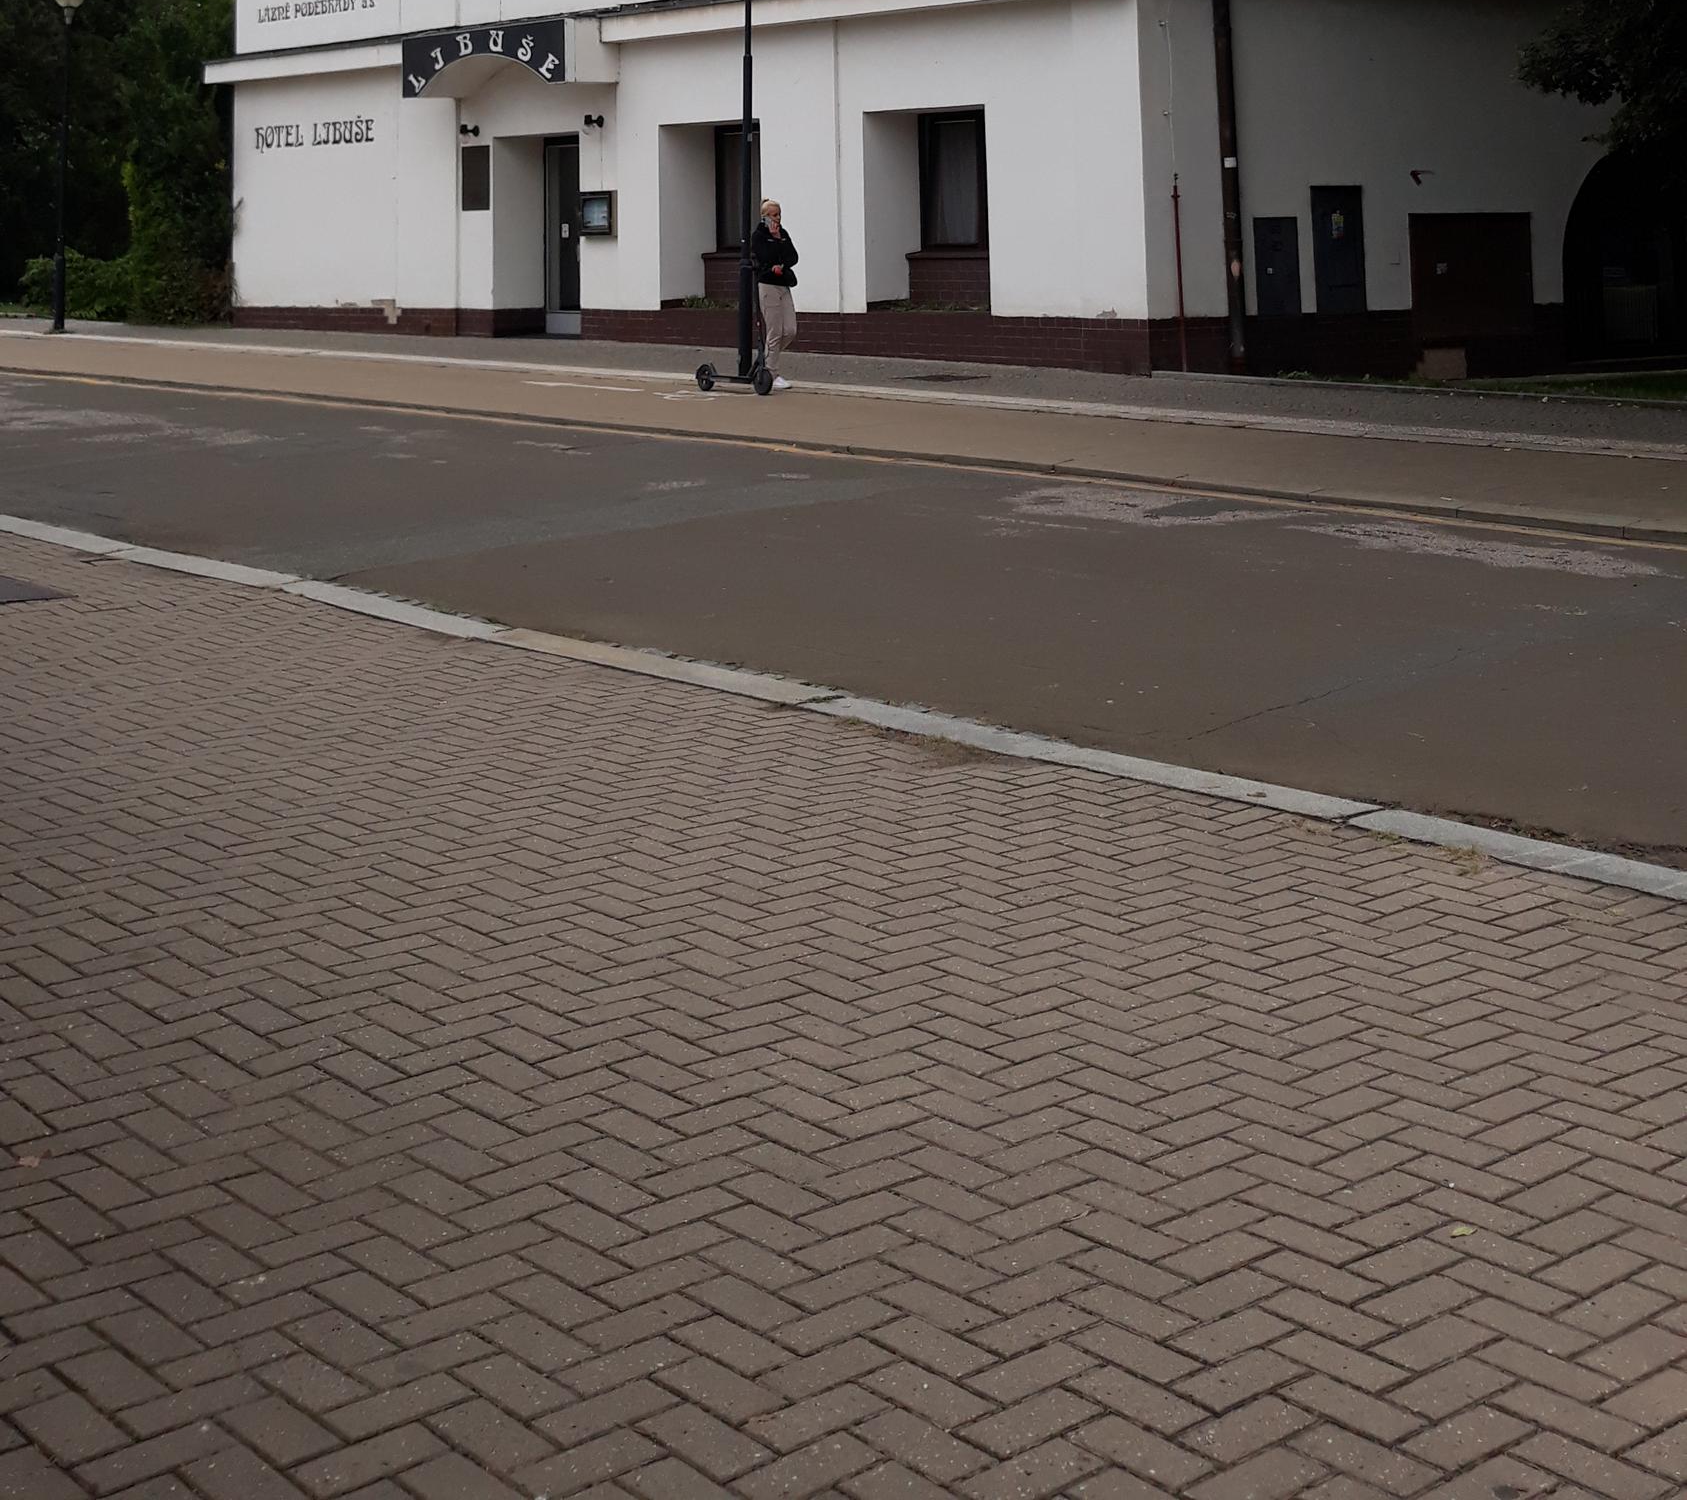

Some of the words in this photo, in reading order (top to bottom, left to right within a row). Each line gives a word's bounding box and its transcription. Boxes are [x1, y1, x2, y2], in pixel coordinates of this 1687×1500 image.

[407, 30, 560, 93] LIBUŠE
[254, 124, 304, 153] HOTEL
[312, 115, 375, 146] LIBUŠE
